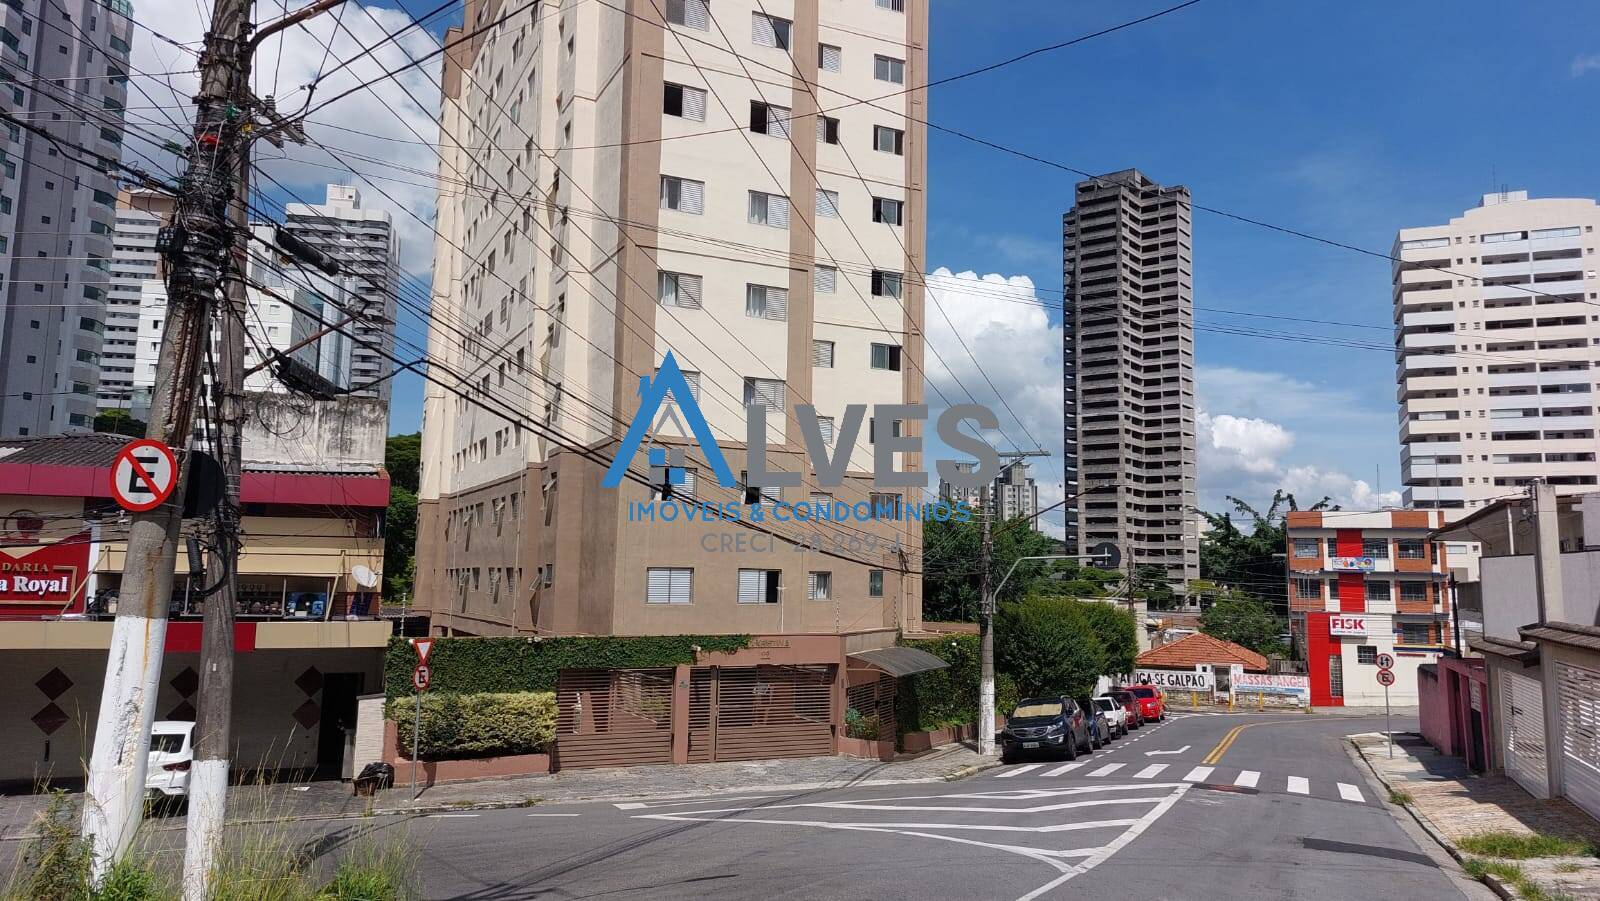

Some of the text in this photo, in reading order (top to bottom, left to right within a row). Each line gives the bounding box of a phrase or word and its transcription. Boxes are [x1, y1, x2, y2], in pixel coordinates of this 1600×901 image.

[129, 457, 159, 493] E
[12, 575, 68, 595] Royal
[1332, 618, 1365, 630] FISK
[1233, 673, 1273, 687] MASSAS
